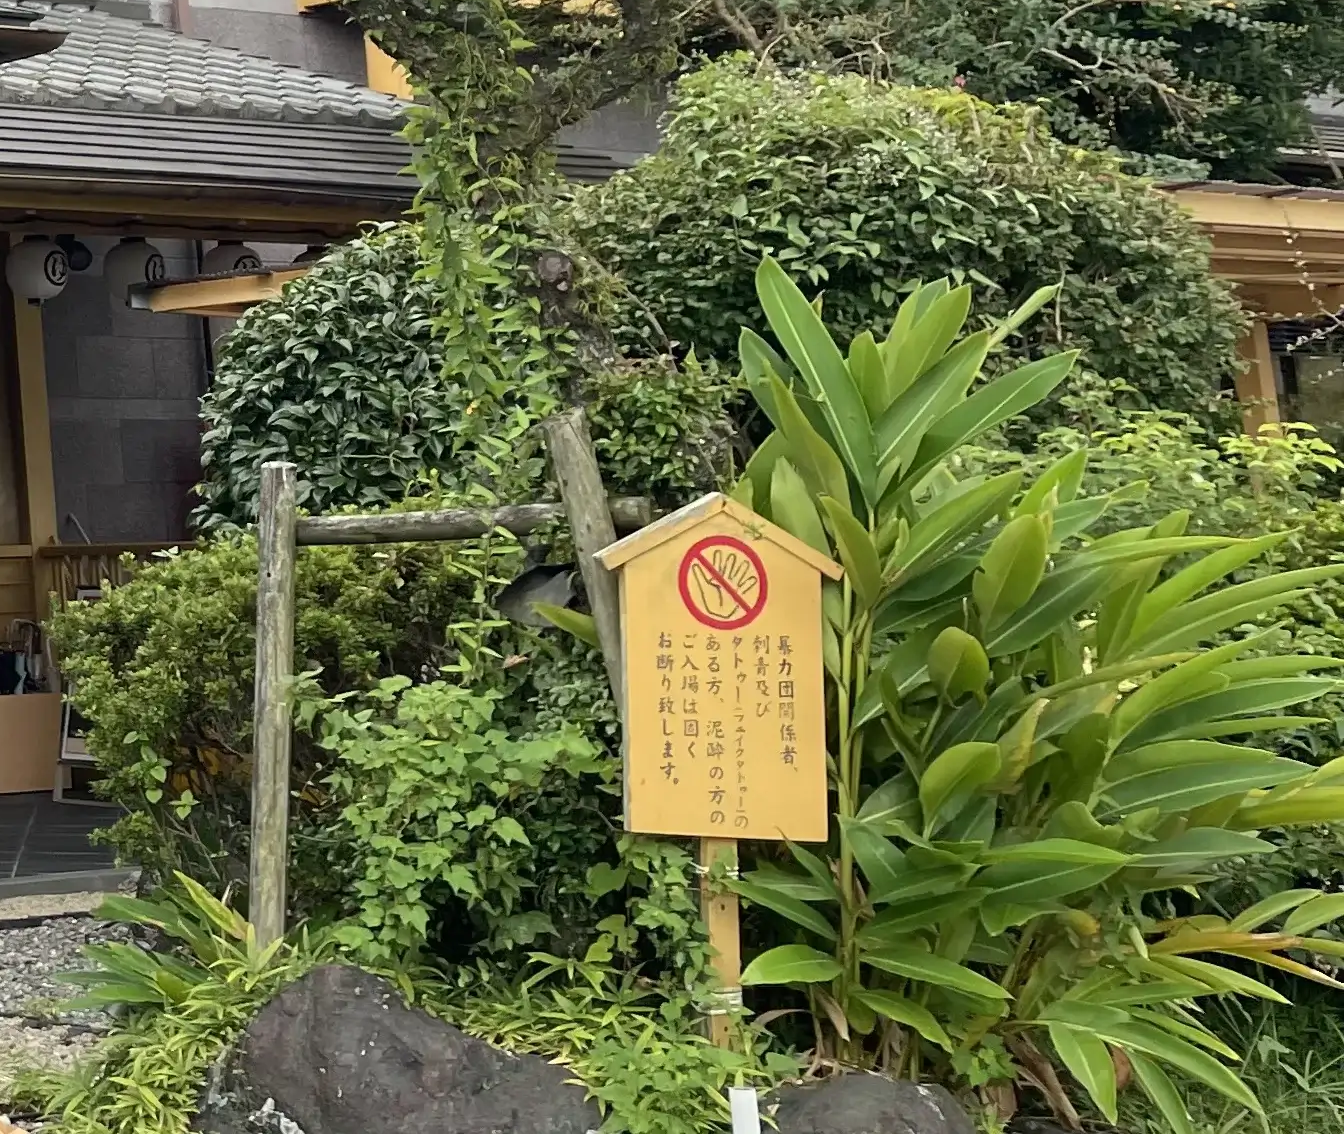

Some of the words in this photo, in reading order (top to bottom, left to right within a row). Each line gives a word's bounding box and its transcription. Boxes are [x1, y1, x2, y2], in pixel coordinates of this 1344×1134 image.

[655, 631, 681, 786] お断り致します。
[680, 632, 701, 760] ご入場は固く
[752, 634, 772, 718] 刺青及び
